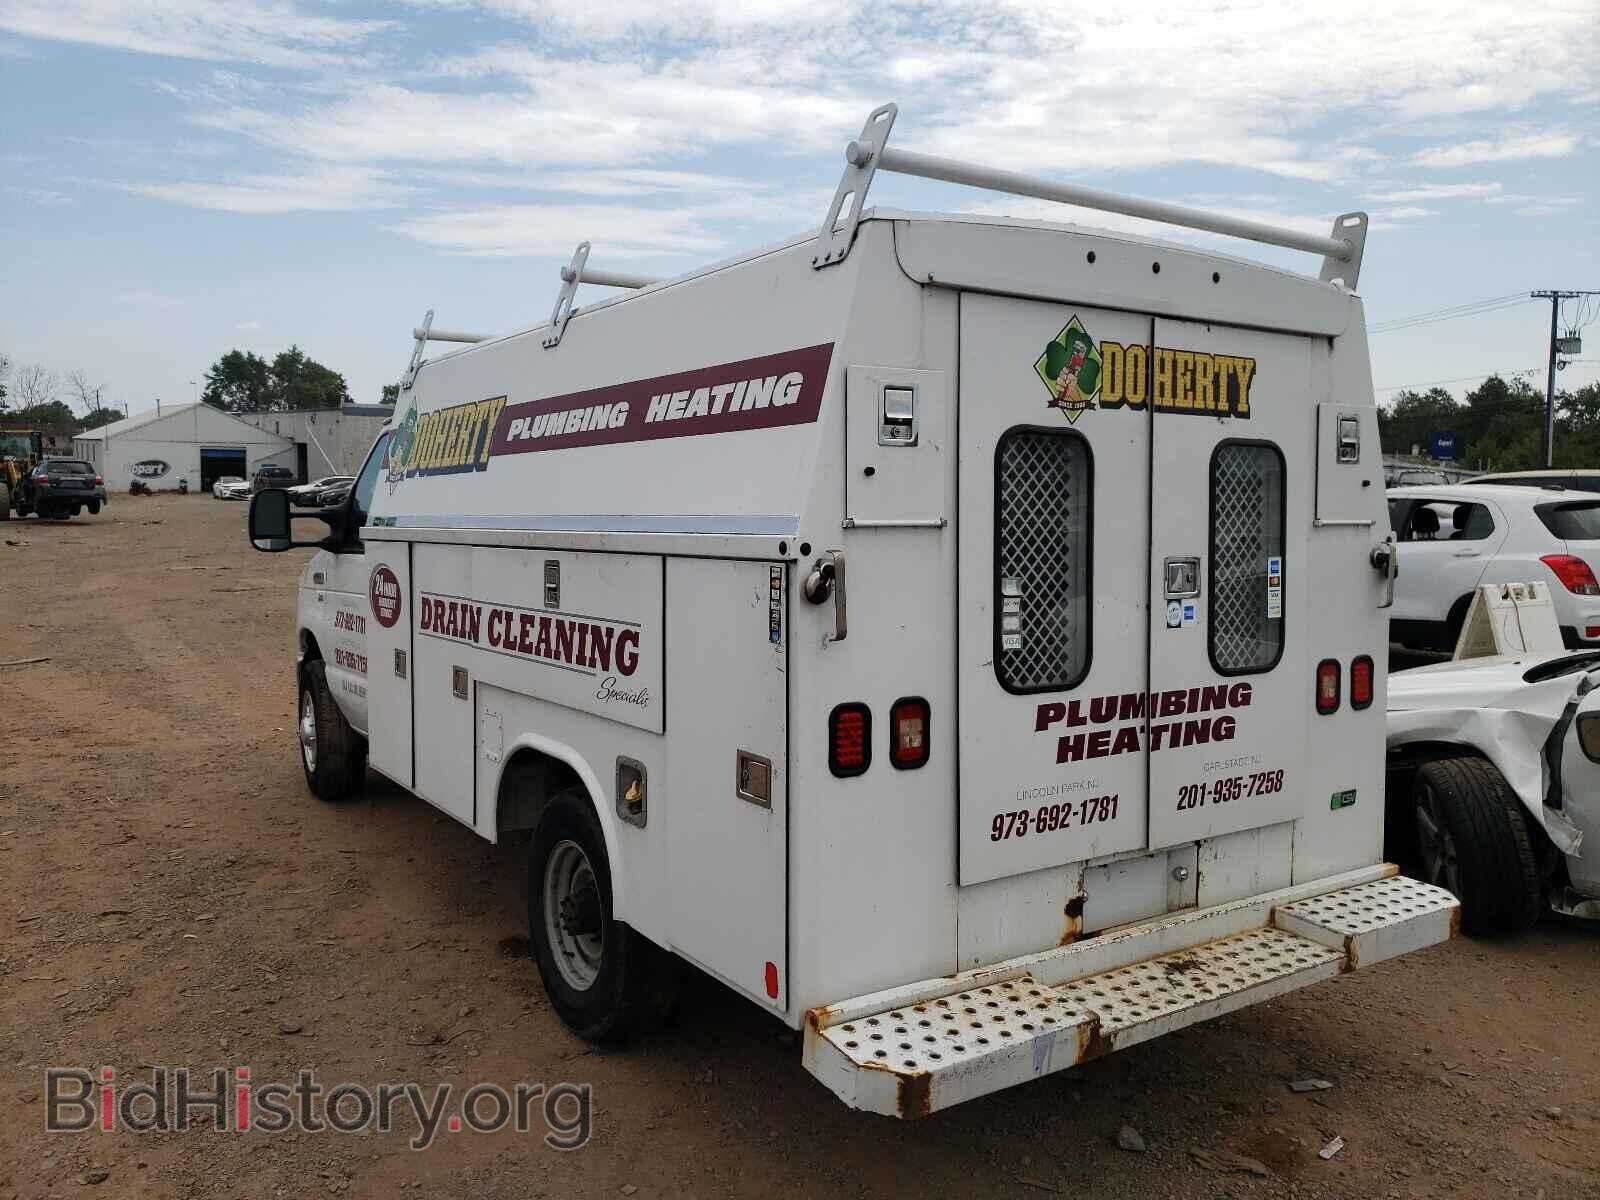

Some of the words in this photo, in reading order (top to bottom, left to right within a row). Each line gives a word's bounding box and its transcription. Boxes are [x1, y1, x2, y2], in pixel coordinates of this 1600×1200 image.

[1099, 341, 1257, 419] DOHERTY
[507, 401, 630, 441] PLUMBING
[645, 372, 803, 423] HEATING
[406, 395, 507, 478] DOHERTY
[130, 463, 164, 475] opart
[375, 573, 384, 595] 24
[420, 596, 482, 643] DRAIN
[488, 608, 640, 676] CLEANING
[1034, 682, 1253, 732] PLUMBING
[1056, 715, 1237, 764] HEATING
[1016, 784, 1059, 800] LINCOLN
[1176, 769, 1285, 811] 201-935-7258
[990, 794, 1119, 842] 973-692-1781
